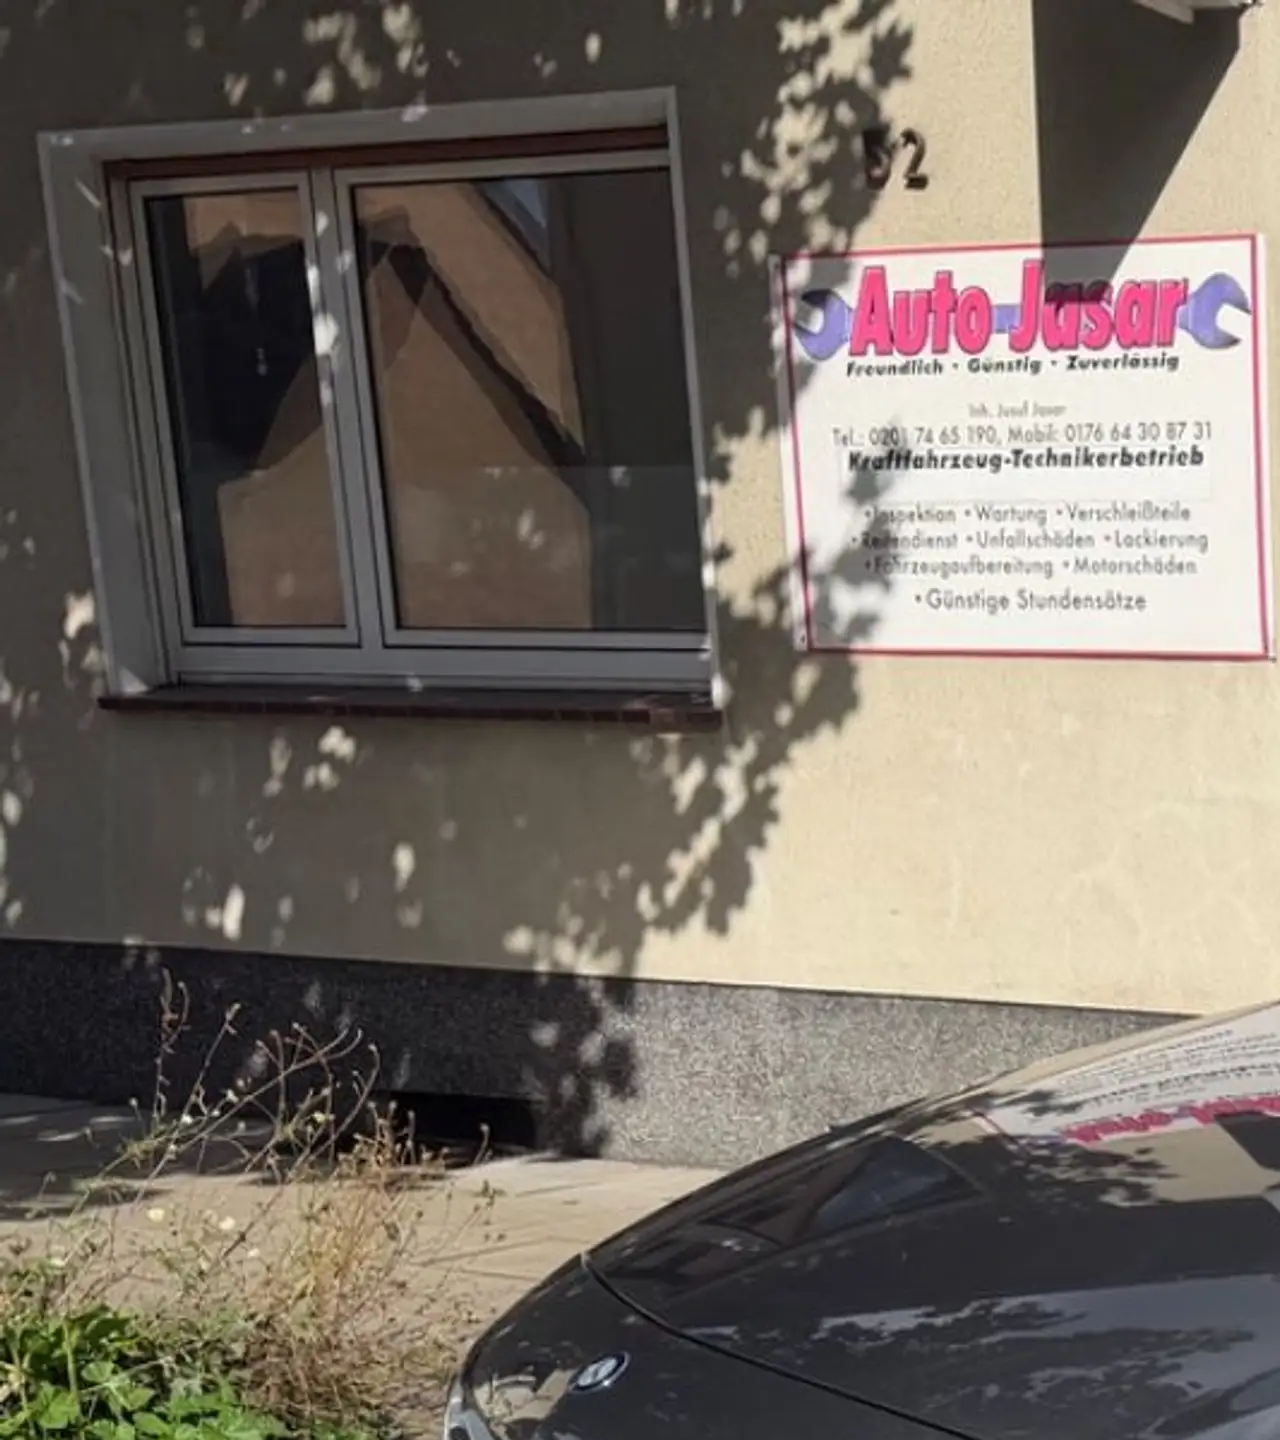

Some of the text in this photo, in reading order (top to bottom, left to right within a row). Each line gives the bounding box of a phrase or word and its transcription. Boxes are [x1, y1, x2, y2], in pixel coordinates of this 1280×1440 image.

[862, 128, 929, 190] 52
[849, 259, 1190, 357] Auto Jasar
[846, 351, 1180, 377] Freundlich Günstig Zuverlässig
[1065, 422, 1104, 442] 0176
[1110, 422, 1132, 442] 64
[1193, 420, 1212, 440] 31
[848, 443, 1205, 474] Kraftfahrzeug-Technikerbetrieb
[975, 503, 1048, 527] Wartung
[1114, 527, 1209, 555] Lackierung
[1073, 553, 1199, 575] Motorschäden
[926, 586, 1148, 616] Günstige Stundensätze
